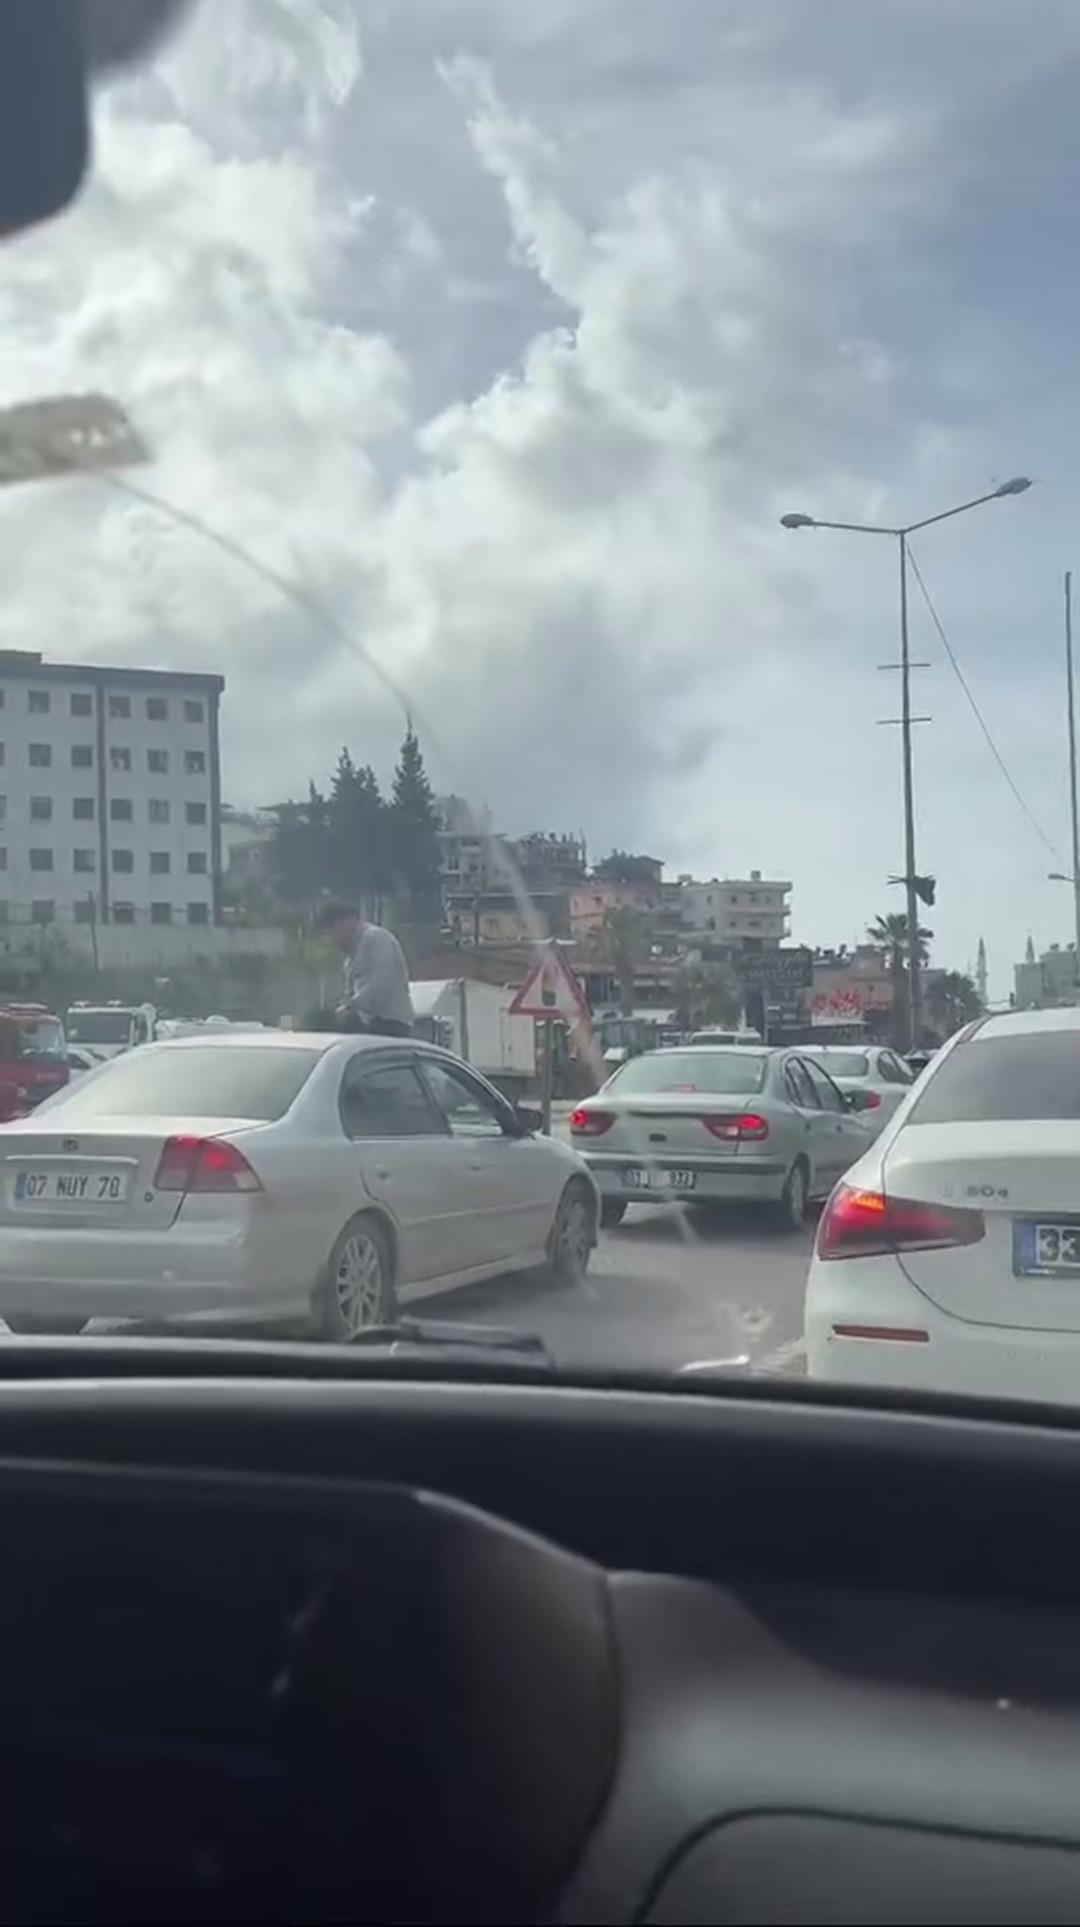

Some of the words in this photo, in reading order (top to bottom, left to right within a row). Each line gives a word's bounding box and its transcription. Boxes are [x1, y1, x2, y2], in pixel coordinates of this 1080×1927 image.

[27, 1175, 47, 1197] 07
[57, 1175, 88, 1197] NUY
[98, 1175, 120, 1198] 70
[1039, 1227, 1080, 1263] 33
